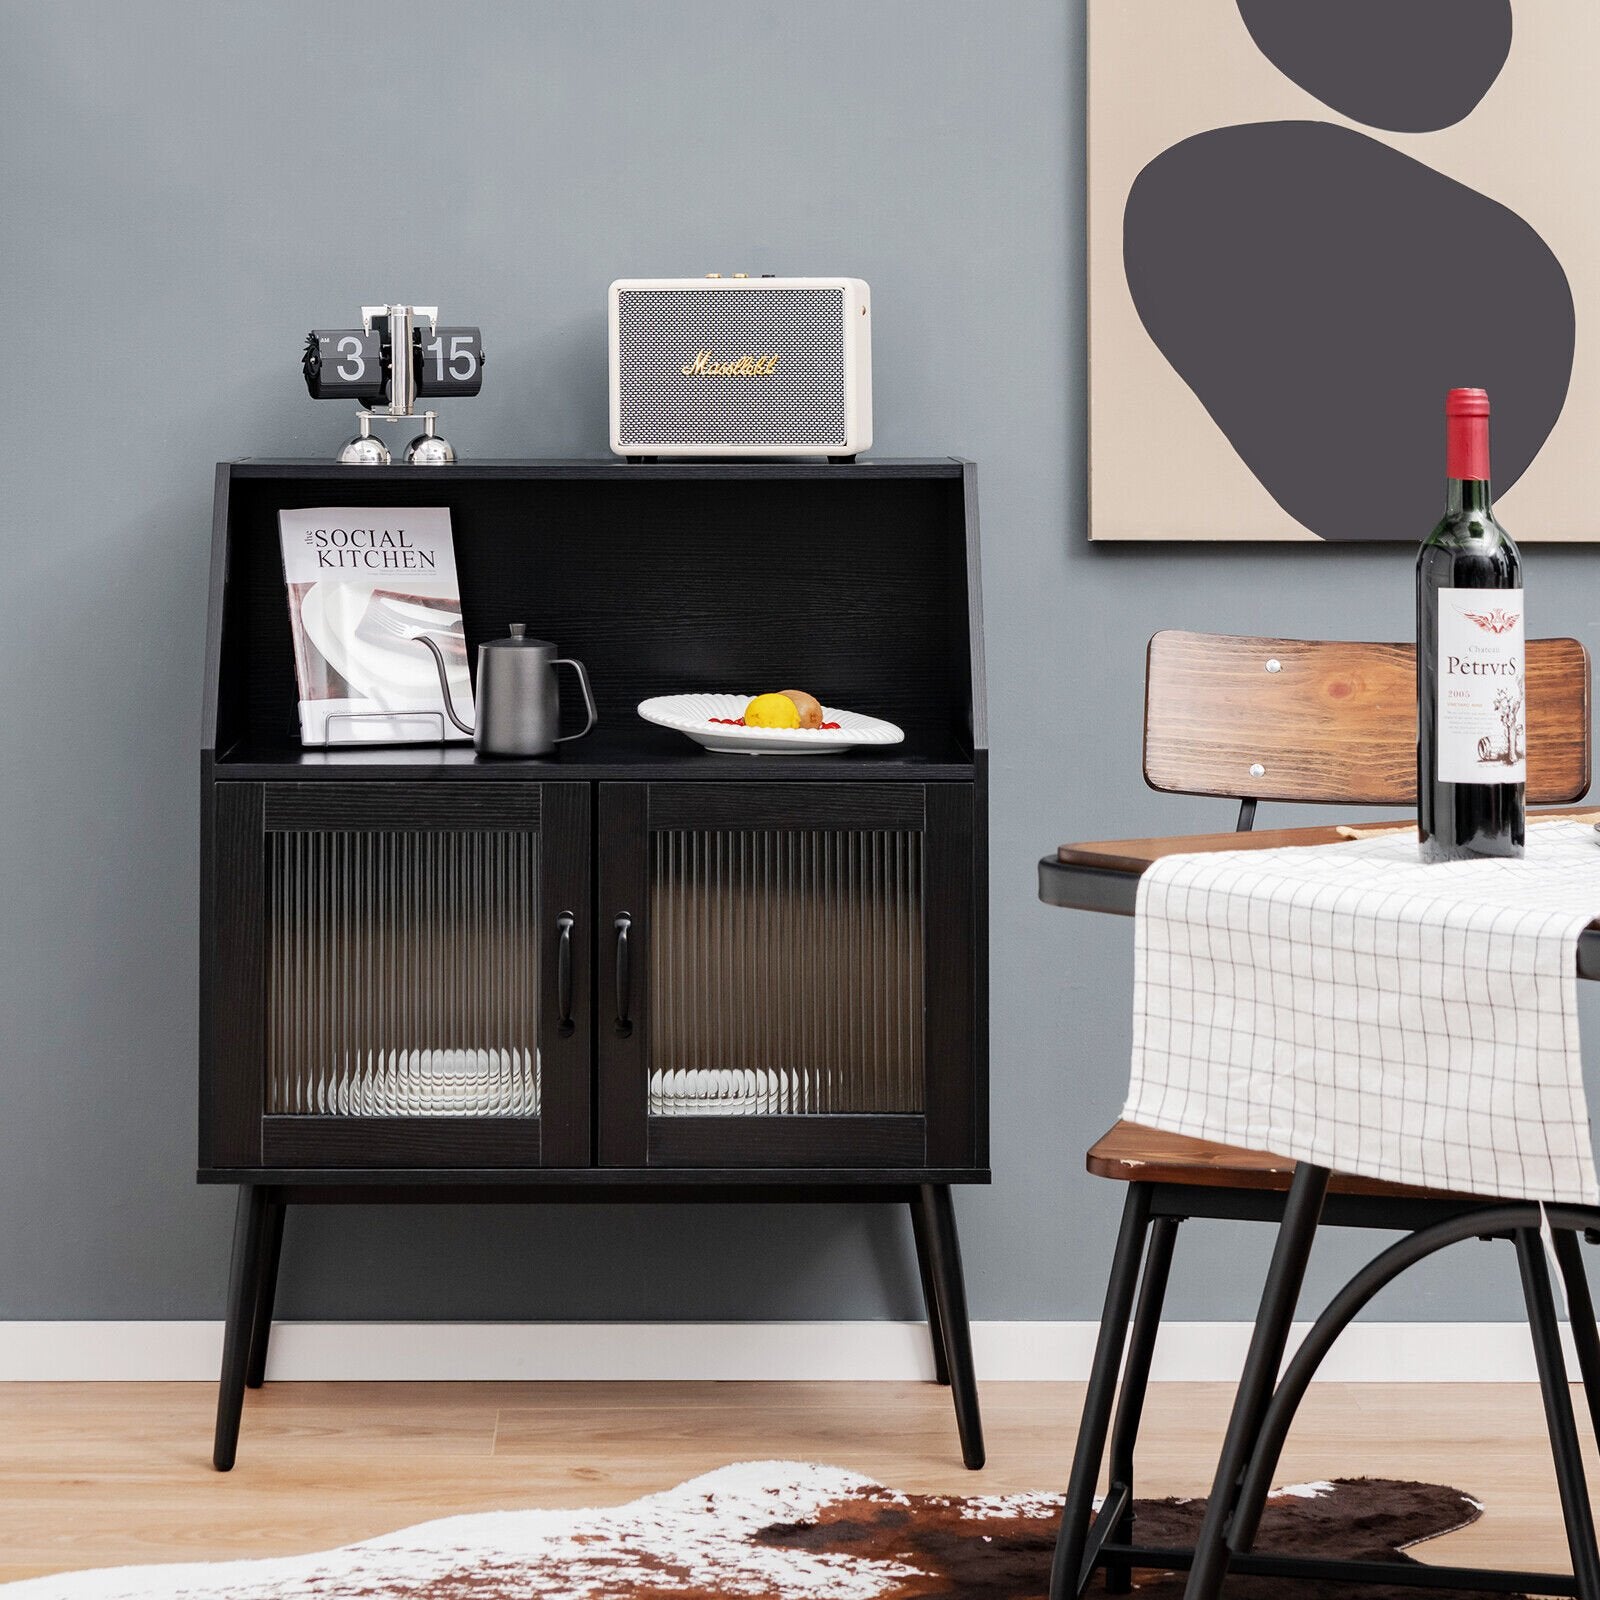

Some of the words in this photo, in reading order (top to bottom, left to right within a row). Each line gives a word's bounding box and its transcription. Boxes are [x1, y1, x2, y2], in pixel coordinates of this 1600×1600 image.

[336, 336, 365, 381] 3
[427, 336, 477, 381] 15
[304, 530, 313, 545] the
[315, 528, 414, 549] SOCIAL
[317, 549, 437, 569] KITCHEN
[1448, 690, 1471, 698] 2005
